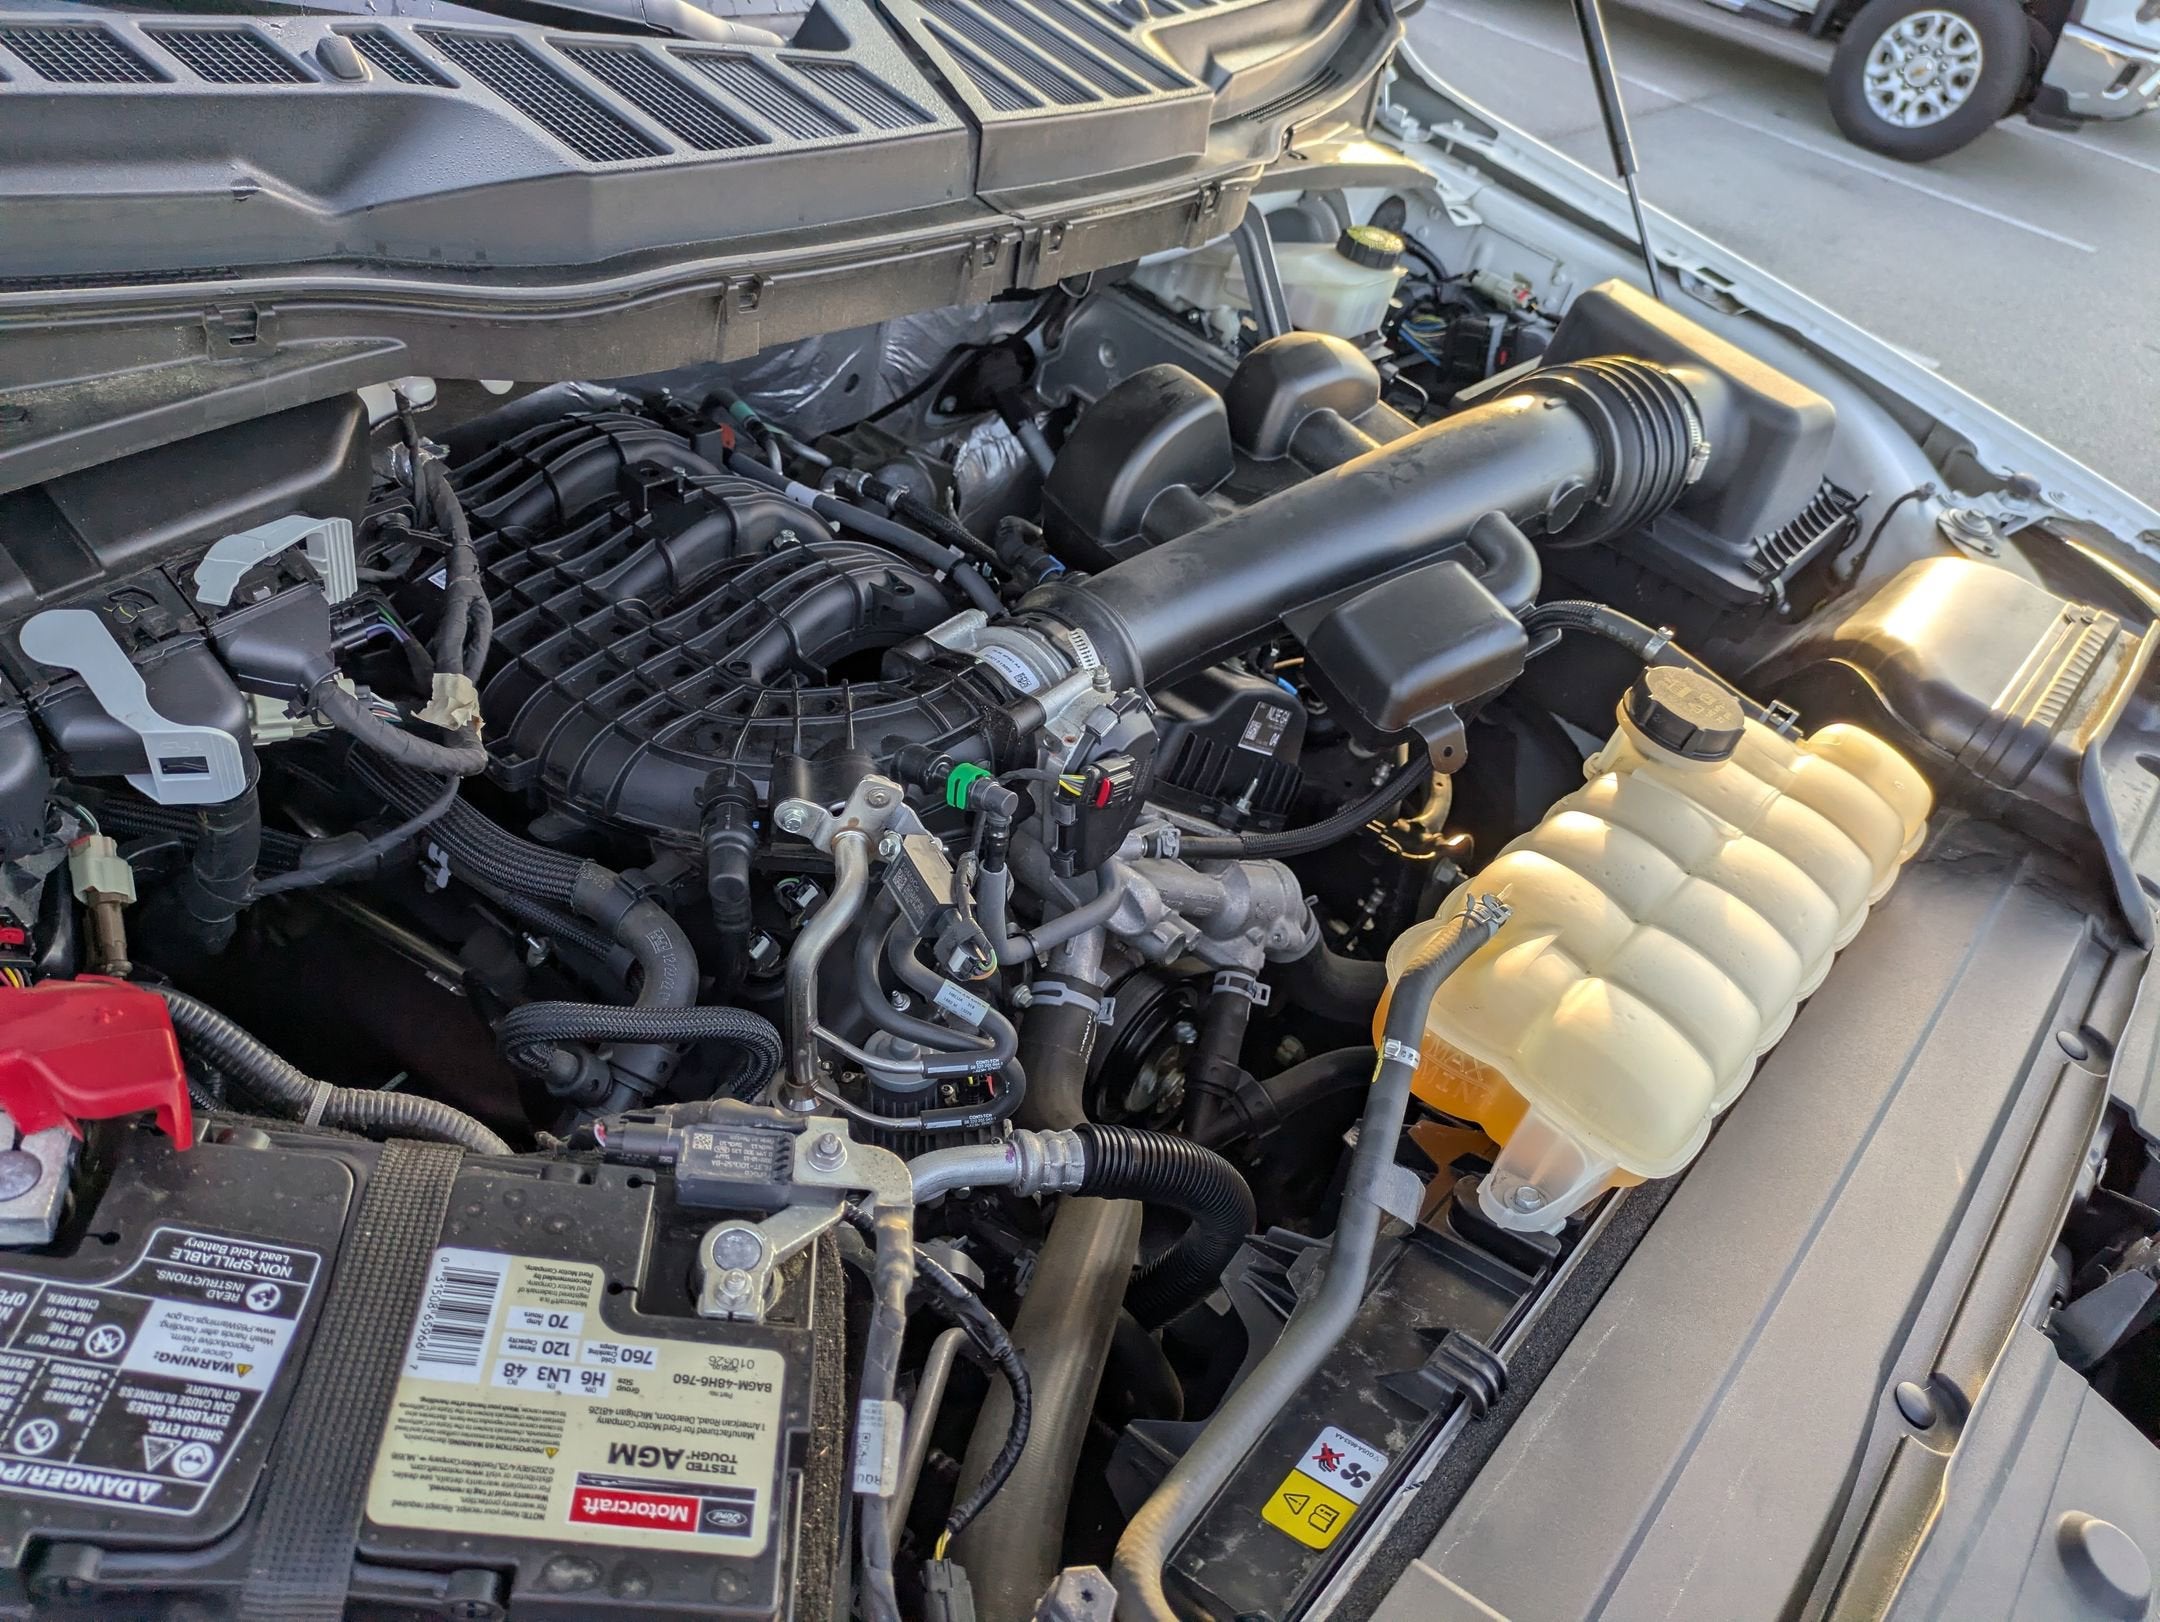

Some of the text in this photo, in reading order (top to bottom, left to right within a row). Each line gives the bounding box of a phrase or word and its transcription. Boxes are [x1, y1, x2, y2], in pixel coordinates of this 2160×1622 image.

[1429, 1037, 1484, 1081] MAX
[1418, 1057, 1472, 1105] MIN
[182, 1236, 291, 1264] Lead Acid Battery
[166, 1247, 295, 1276] NON-SPILLABLE
[152, 1268, 247, 1290] INSTRUCTIONS.
[542, 1274, 592, 1285] Recommended
[204, 1287, 241, 1301] READ
[525, 1287, 557, 1296] trademark
[558, 1290, 589, 1299] registered
[44, 1291, 101, 1309] CHILDREN.
[39, 1305, 93, 1322] REACH OF
[523, 1311, 544, 1319] Hours
[525, 1317, 542, 1325] Amp
[547, 1313, 570, 1328] 70
[46, 1321, 86, 1336] OF THE
[156, 1319, 275, 1345] Wash hands after handling.
[24, 1332, 79, 1351] KEEP OUT
[168, 1331, 256, 1352] Reproductive Harm.
[507, 1335, 538, 1345] Capacity
[508, 1343, 536, 1352] Reserve
[599, 1342, 618, 1350] Amps
[180, 1344, 234, 1359] Cancer and
[540, 1340, 571, 1356] 120
[587, 1347, 618, 1356] Cranking
[620, 1347, 654, 1364] 760
[150, 1351, 238, 1373] WARNING:
[48, 1361, 102, 1379] SMOKING
[502, 1362, 528, 1378] 48
[535, 1365, 571, 1383] LN3
[49, 1375, 95, 1392] FLAMES
[579, 1370, 606, 1386] H6
[616, 1377, 633, 1385] Size
[672, 1372, 772, 1392] BAGM-48H6-760
[41, 1388, 88, 1405] SPARKS
[181, 1382, 242, 1401] OR INJURY.
[615, 1385, 639, 1393] Group
[115, 1384, 236, 1413] CAN CAUSE BLINDNESS
[66, 1407, 89, 1422] NO
[124, 1399, 231, 1425] EXPLOSIVE GASES
[587, 1405, 614, 1416] 48126
[614, 1406, 653, 1419] Michigan
[653, 1411, 695, 1423] Dearborn,
[596, 1412, 755, 1439] Manufactured for Ford Motor Company
[696, 1415, 720, 1426] Road,
[722, 1418, 760, 1429] American
[143, 1418, 224, 1441] SHIELD EYES.
[606, 1441, 685, 1470] AGM
[685, 1460, 737, 1475] TESTED
[0, 1461, 139, 1497] DANGER/P
[391, 1499, 424, 1509] required
[424, 1502, 453, 1512] Receipt
[482, 1507, 500, 1516] your
[501, 1499, 534, 1509] warranty
[535, 1502, 547, 1510] for
[579, 1496, 689, 1522] Motorcraft
[500, 1508, 520, 1517] Keep
[520, 1510, 545, 1519] NOTE:
